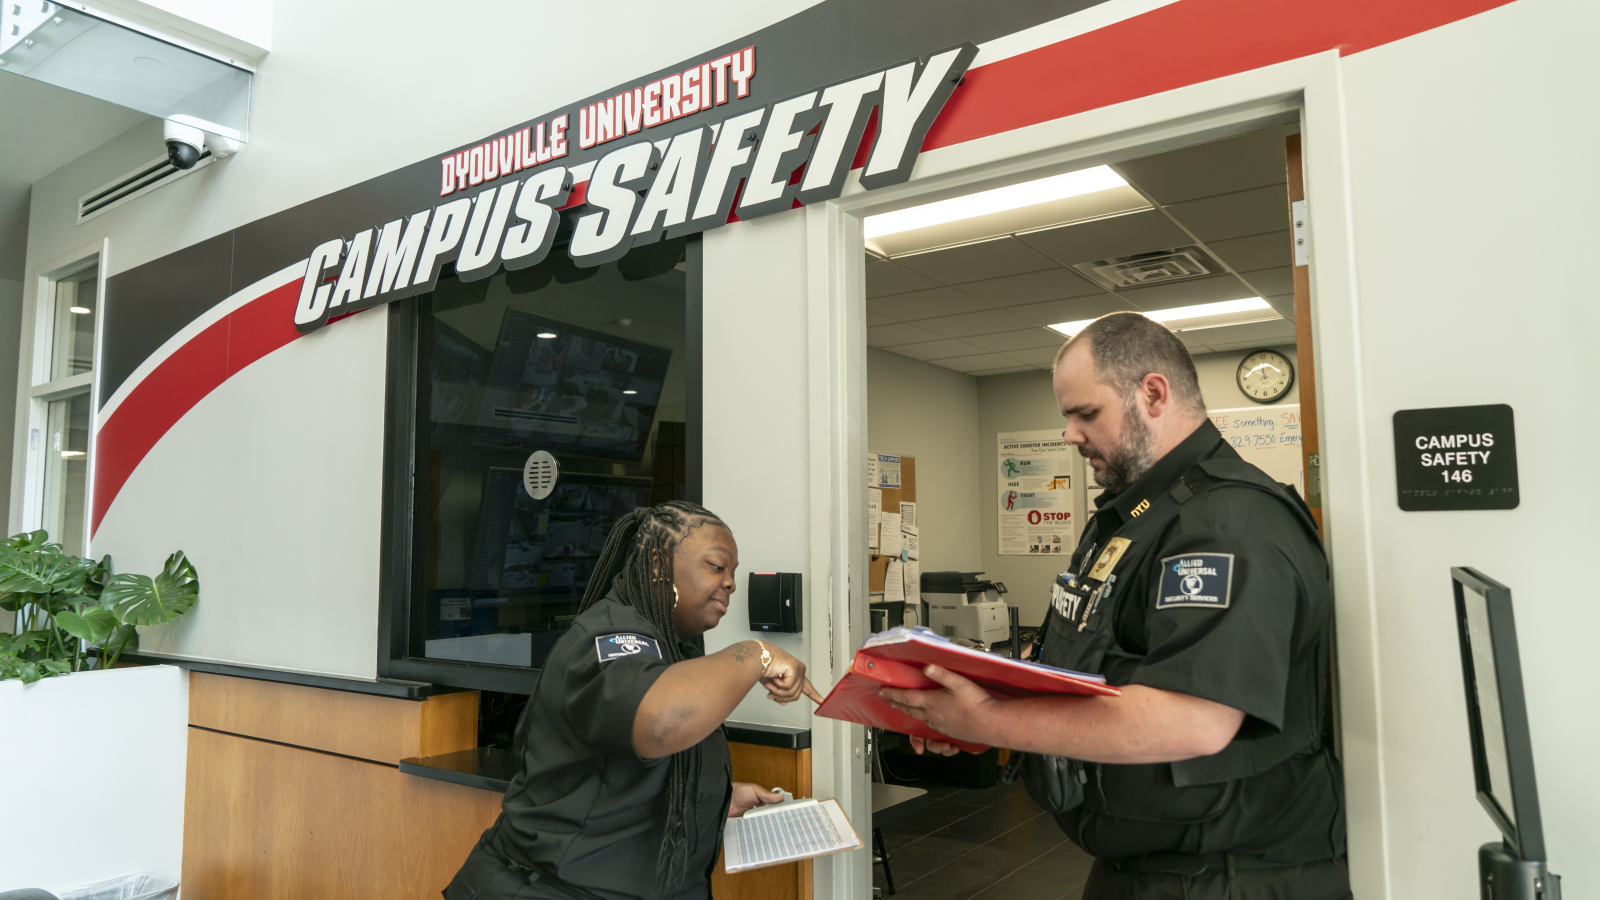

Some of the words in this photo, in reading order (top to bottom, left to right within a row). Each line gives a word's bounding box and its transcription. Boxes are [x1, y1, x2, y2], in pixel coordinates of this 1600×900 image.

[440, 113, 569, 196] DYOUVILLE
[579, 45, 755, 150] UNIVERSITY
[293, 166, 567, 326] CAMPUS
[567, 46, 963, 258] SAFETY
[1415, 432, 1495, 450] CAMPUS
[1420, 450, 1491, 467] SAFETY
[1441, 469, 1473, 483] 146
[1043, 512, 1071, 521] STOP
[1178, 558, 1204, 568] ALLIED
[1177, 567, 1218, 576] UNIVERSAL
